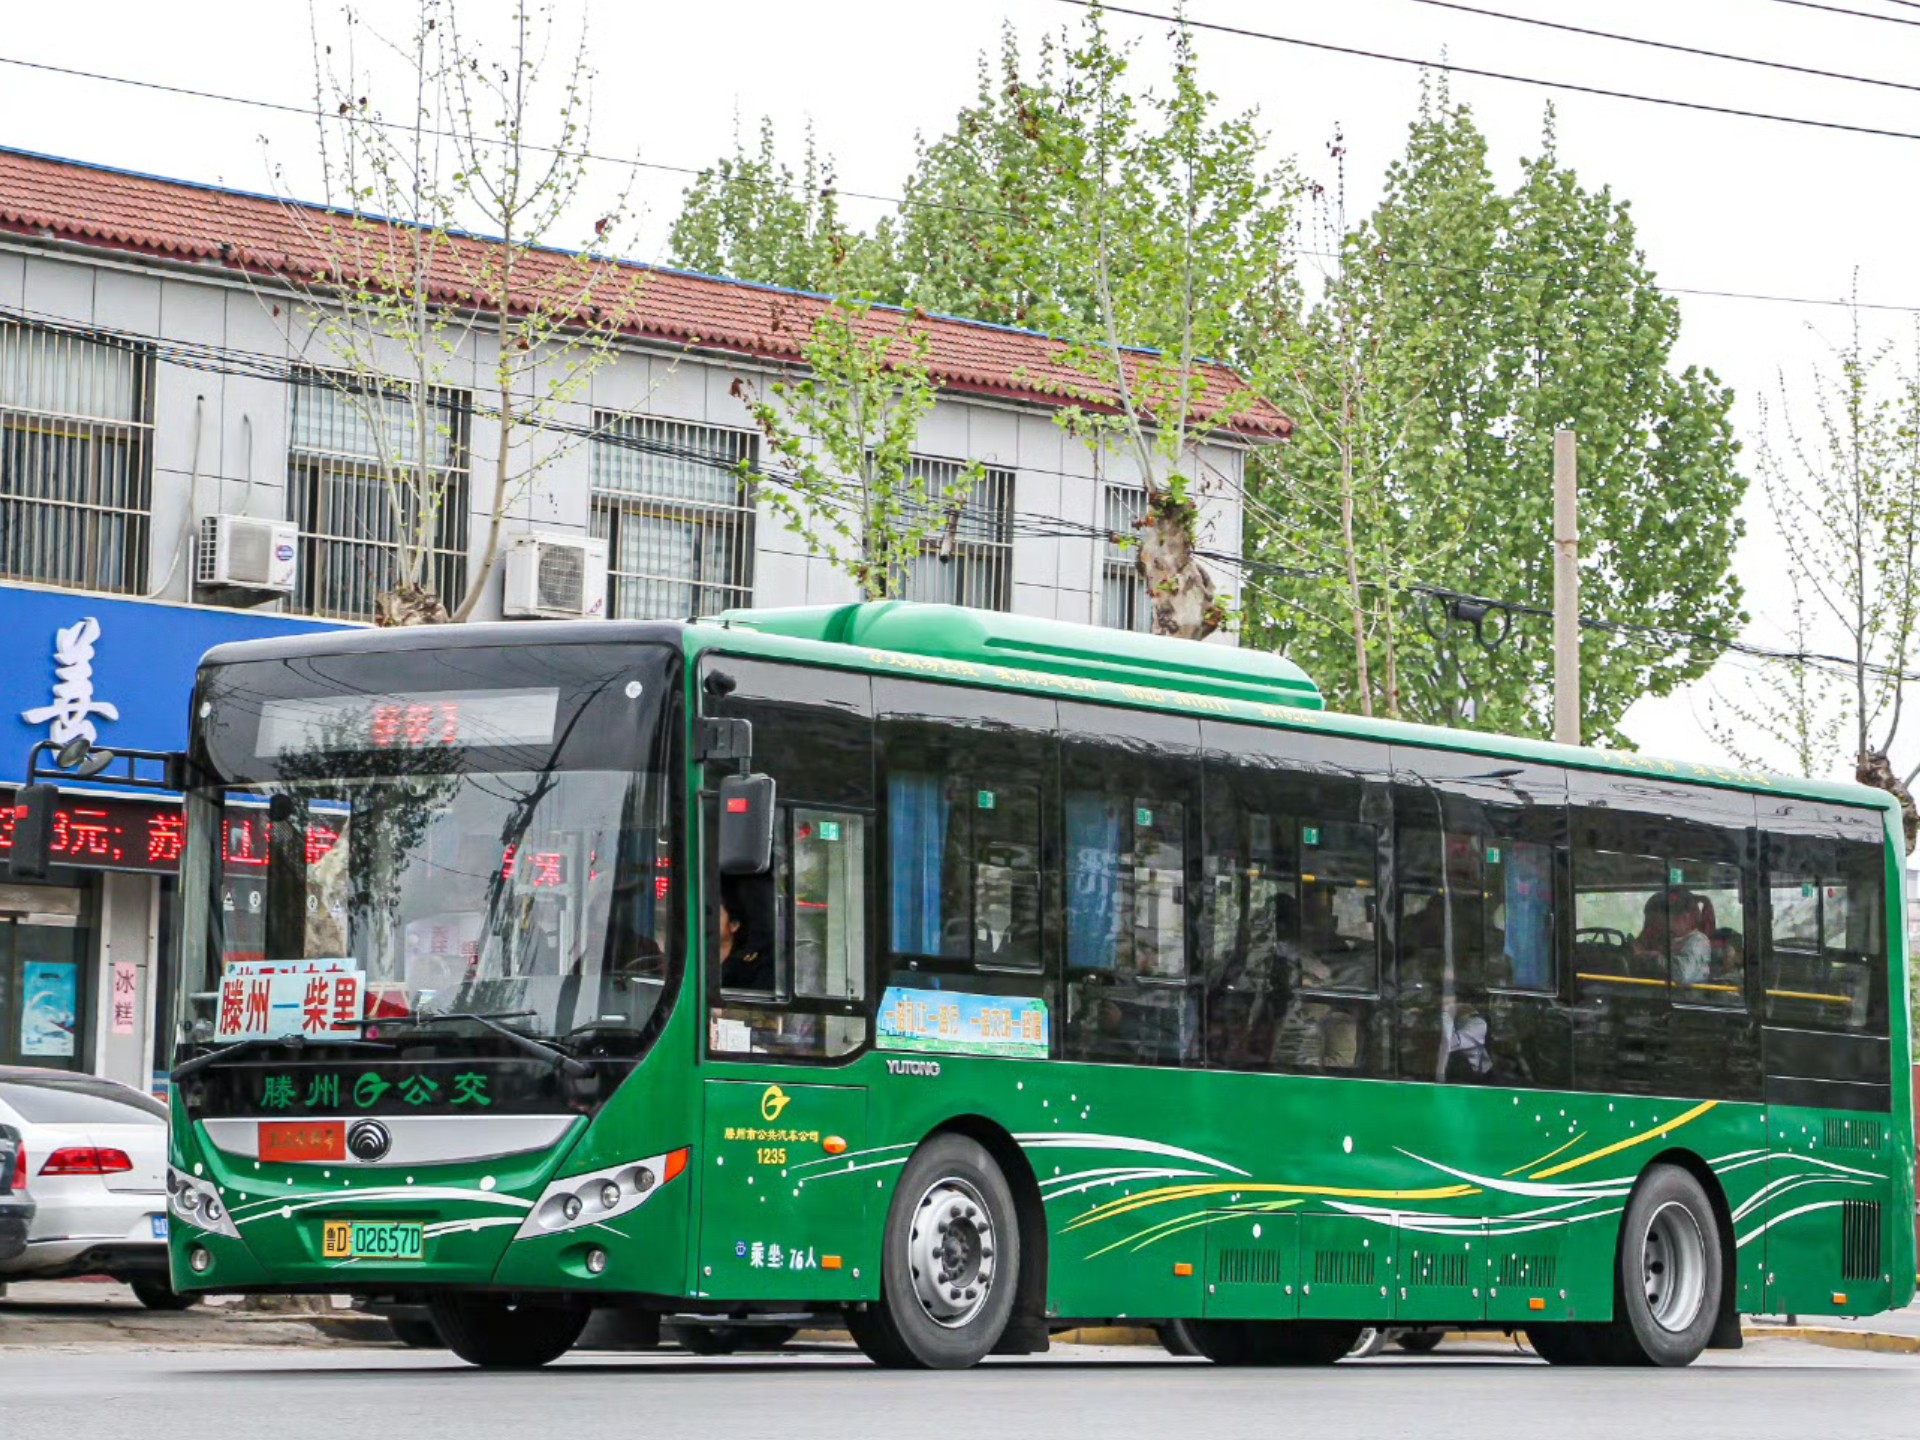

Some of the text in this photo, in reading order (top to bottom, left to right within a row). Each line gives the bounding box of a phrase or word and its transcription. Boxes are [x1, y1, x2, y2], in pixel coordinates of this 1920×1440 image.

[115, 969, 136, 1027] 冰糕
[885, 1059, 941, 1076] YUTONG
[724, 1127, 820, 1143] 滕州市公共汽车公司
[757, 1148, 786, 1165] 1235
